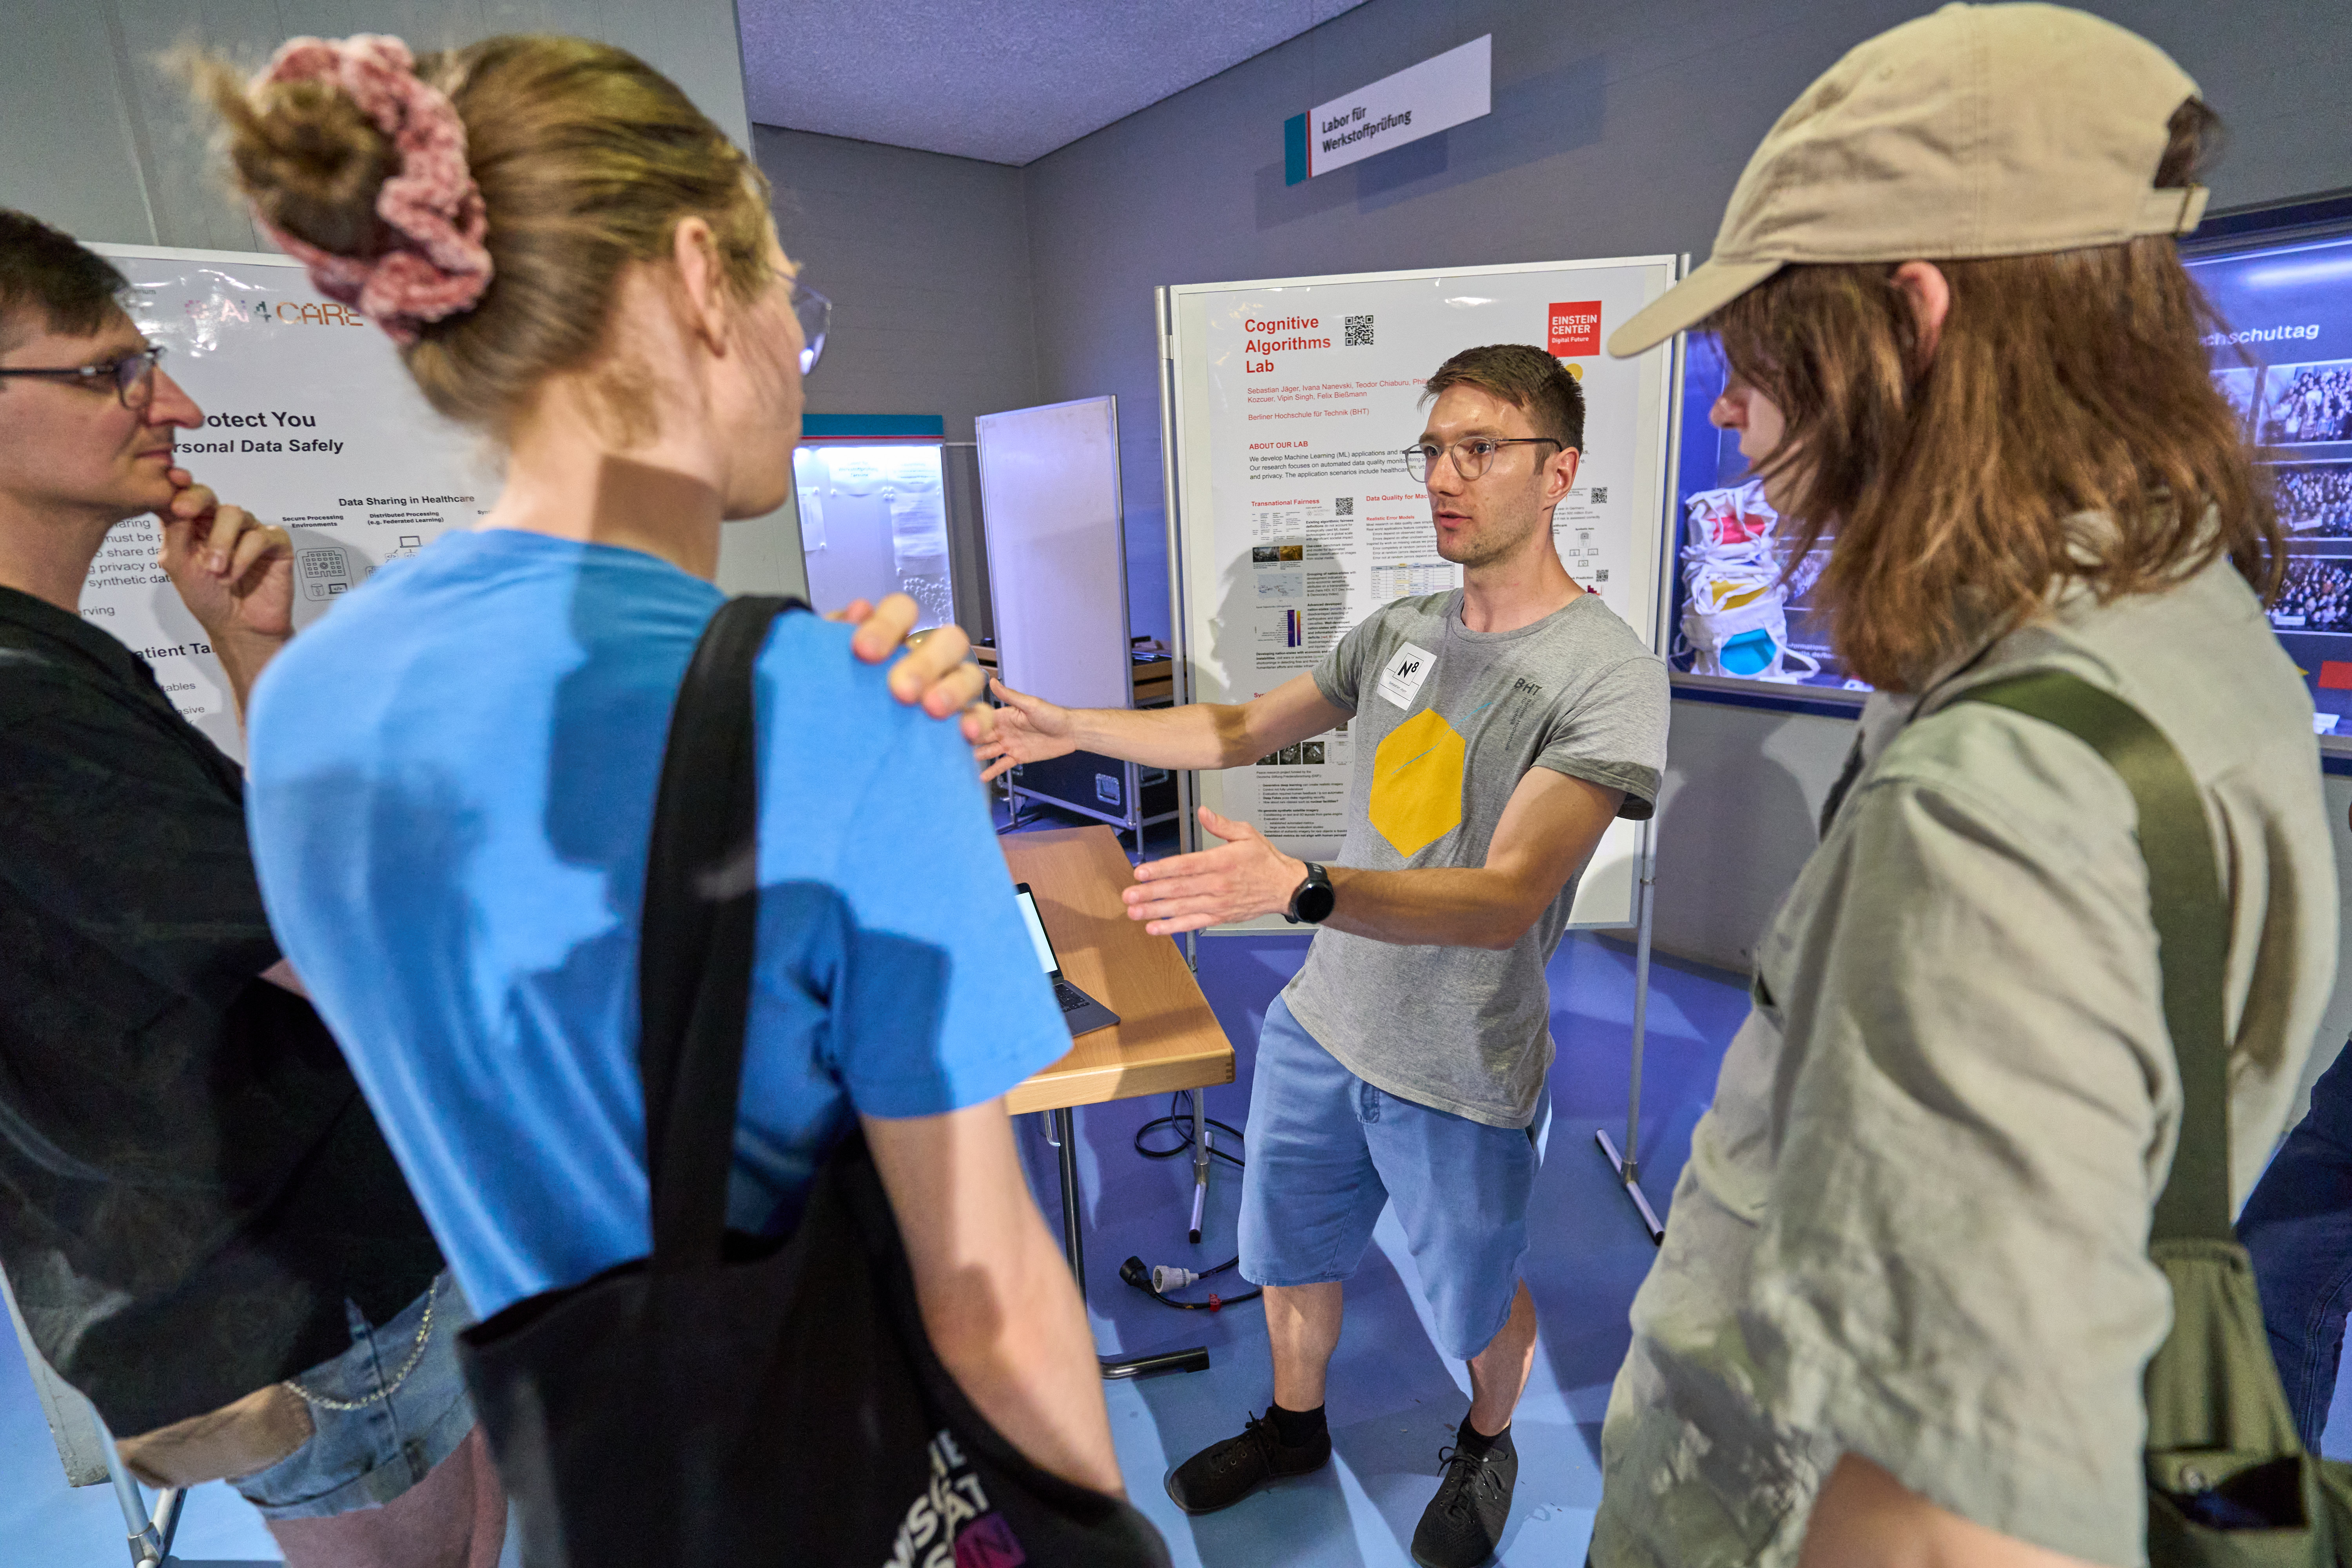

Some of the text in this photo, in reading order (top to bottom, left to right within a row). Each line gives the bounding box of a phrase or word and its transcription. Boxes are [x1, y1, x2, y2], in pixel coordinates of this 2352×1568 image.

[1322, 106, 1367, 134] Labor für
[1322, 110, 1412, 152] Werkstoffprüfung
[1245, 316, 1319, 334] Cognitive
[1552, 315, 1597, 325] EINSTEIN
[1552, 325, 1590, 334] CENTER
[2200, 325, 2319, 347] chschultag
[1245, 337, 1330, 355] Algorithms
[1247, 359, 1274, 373] Lab
[207, 412, 316, 427] otect You
[173, 439, 344, 454] rsonal Data Safely
[367, 497, 407, 506] Sharing
[137, 533, 153, 541] be
[107, 548, 143, 557] share
[100, 563, 145, 573] privacy
[89, 574, 171, 588] synthetic dat
[83, 606, 115, 616] rving
[135, 642, 211, 659] atient Ta
[1514, 677, 1543, 696] BHT
